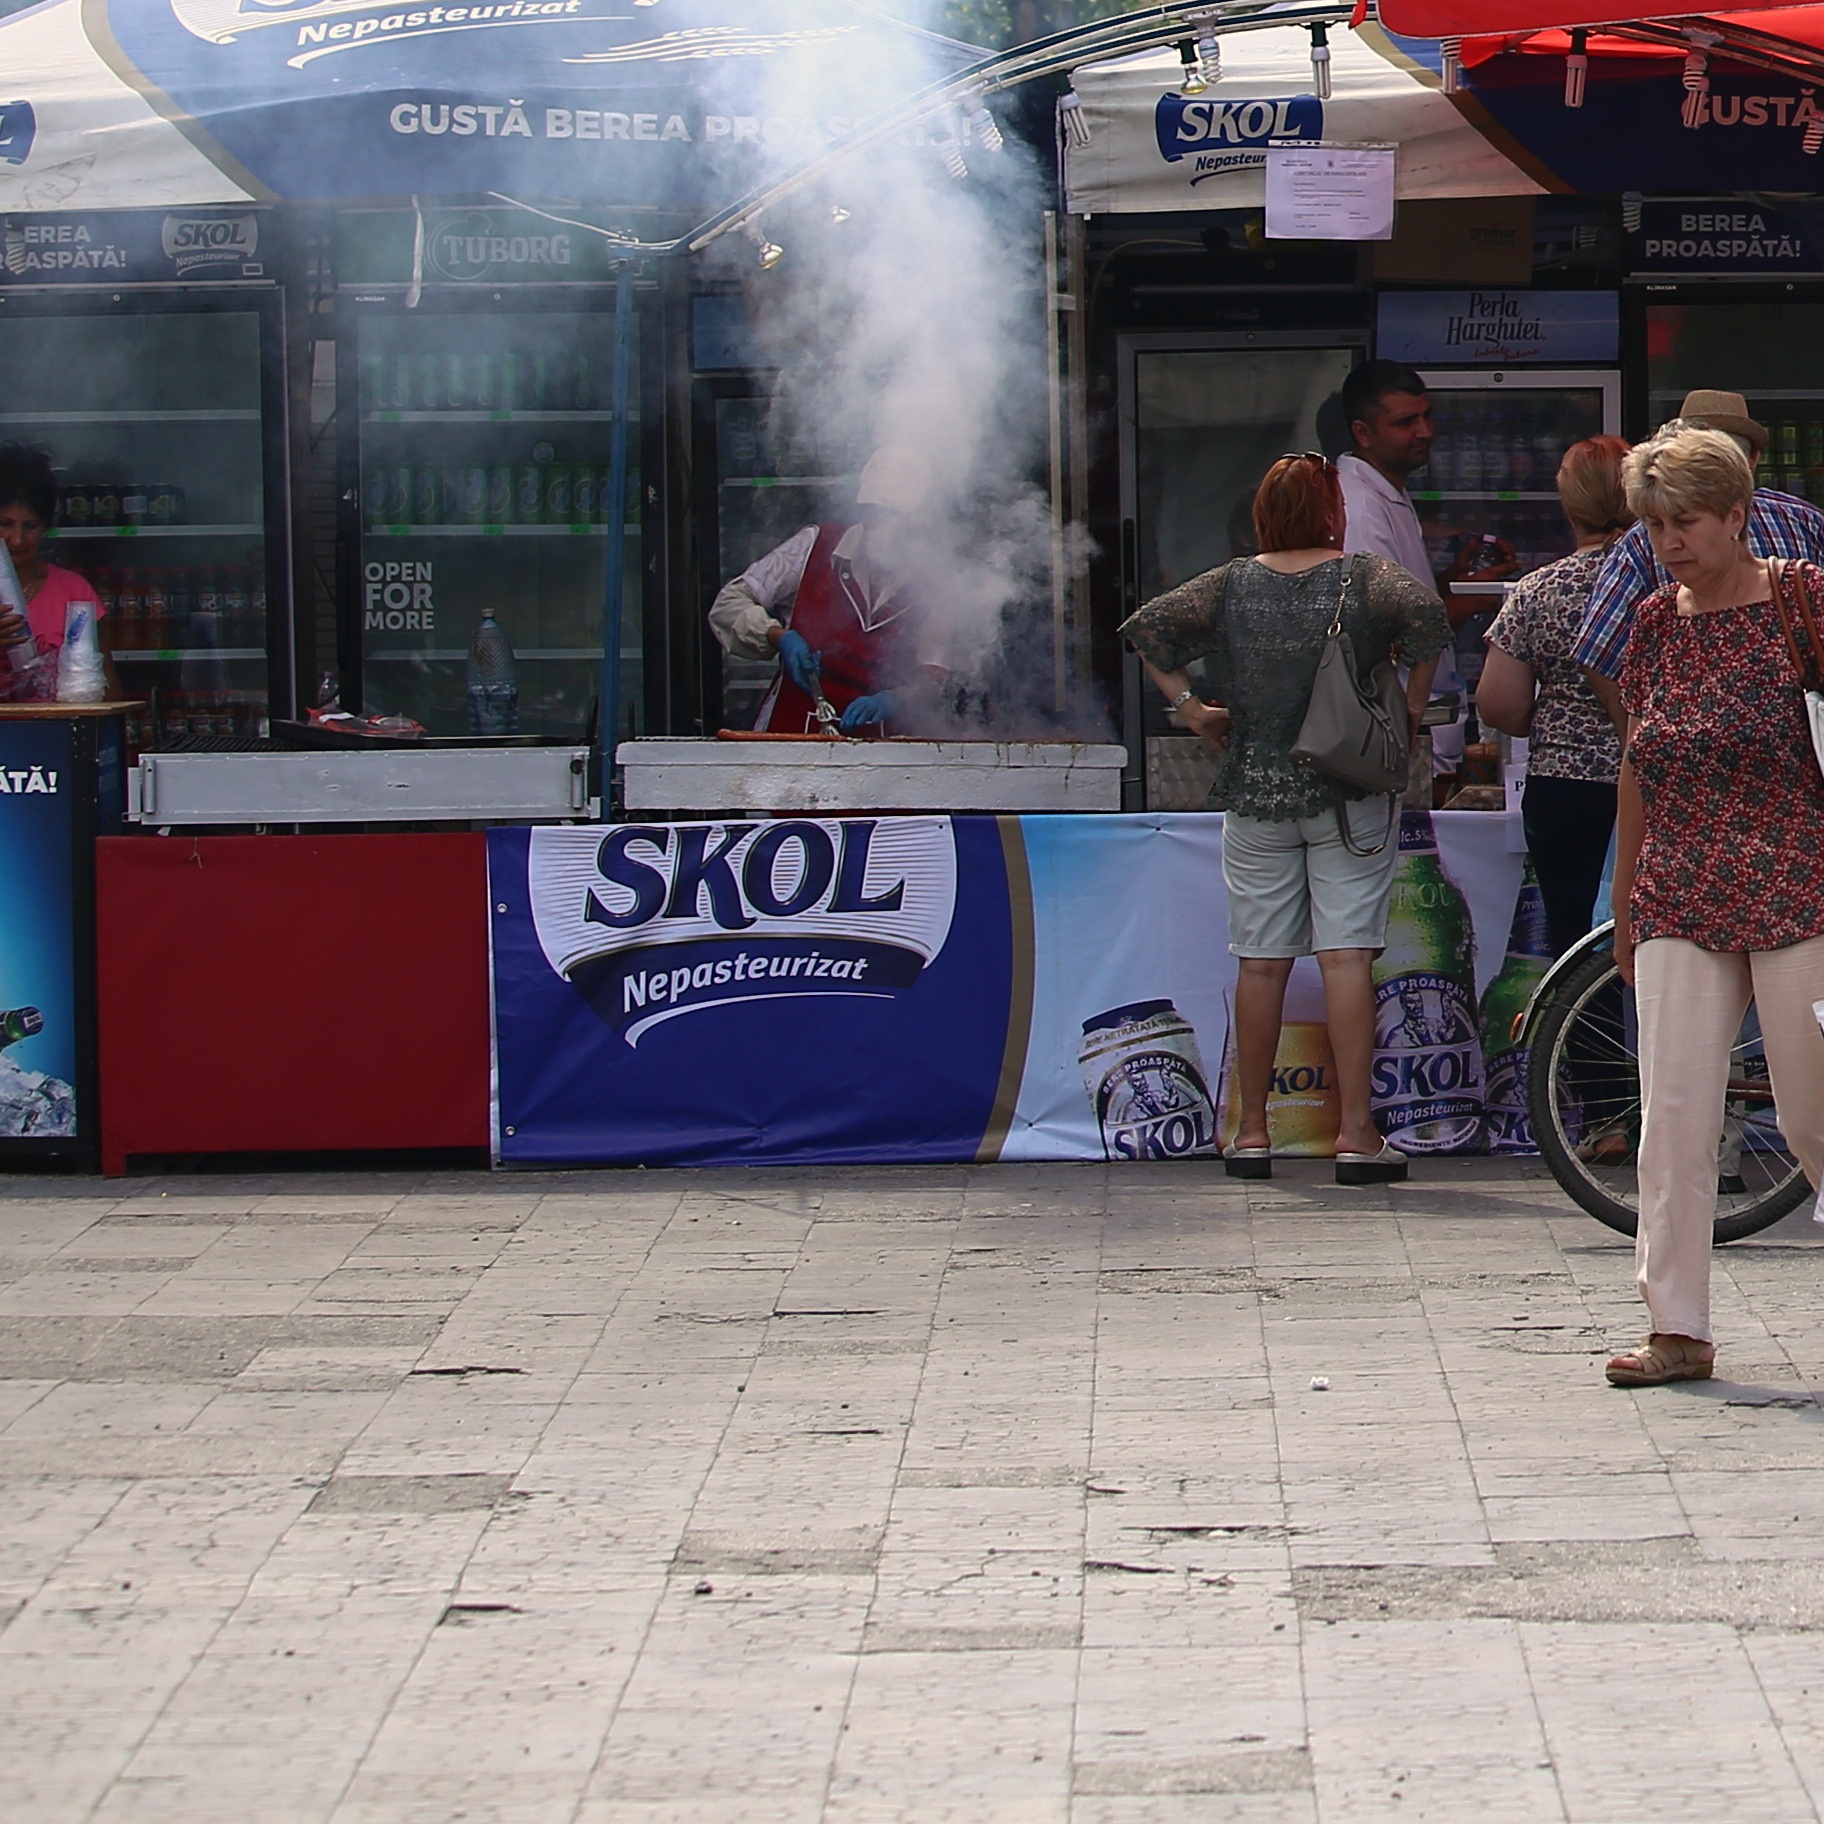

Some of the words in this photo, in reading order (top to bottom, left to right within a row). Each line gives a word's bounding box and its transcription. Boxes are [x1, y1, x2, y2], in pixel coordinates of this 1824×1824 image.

[390, 98, 533, 138] GUSTĂ
[545, 108, 692, 142] BEREA
[1176, 101, 1301, 143] SKOL
[1195, 154, 1267, 172] Nepasteur
[24, 225, 91, 244] EREA
[173, 222, 247, 247] SKOL
[1681, 214, 1766, 232] BEREA
[442, 232, 571, 266] TUBORG
[1645, 234, 1801, 258] PROASPĂTĂ!
[1468, 293, 1521, 318] Perla
[364, 562, 433, 582] OPEN
[364, 583, 434, 610] FOR
[364, 611, 434, 630] MORE
[584, 819, 905, 931] SKOL
[623, 951, 869, 1014] Nepasteurizat
[1269, 1066, 1333, 1095] KOL
[1372, 1049, 1480, 1100] SKOL
[1386, 1101, 1474, 1127] Nepasteurizat
[1114, 1110, 1217, 1160] SKOL
